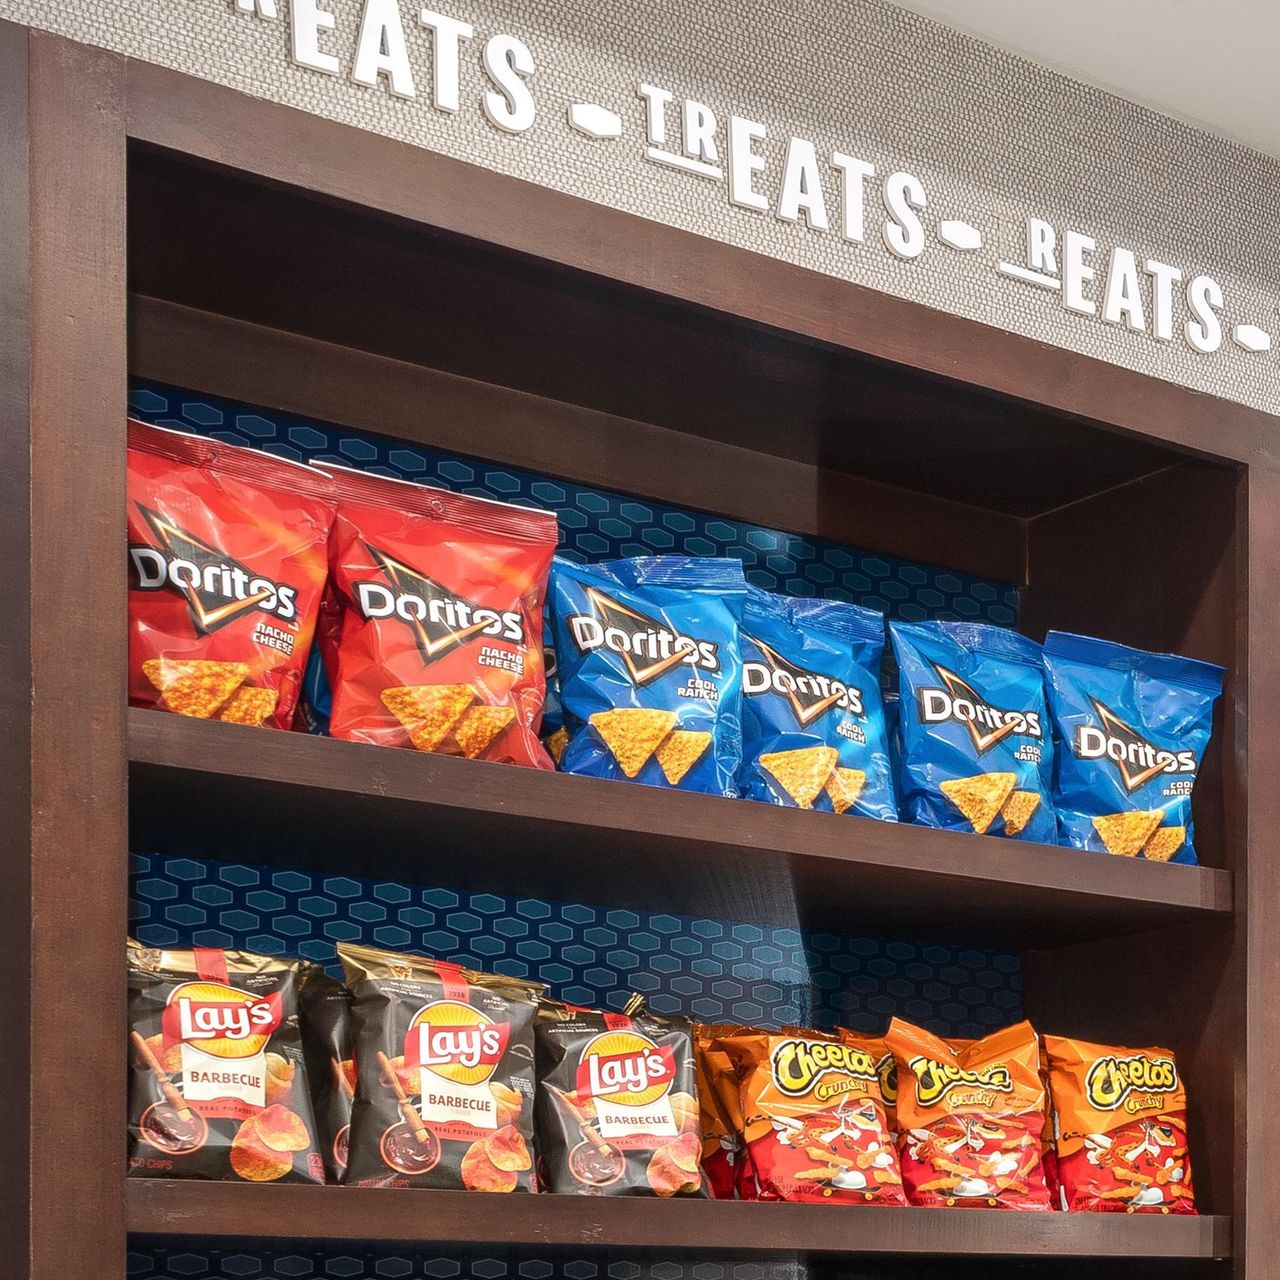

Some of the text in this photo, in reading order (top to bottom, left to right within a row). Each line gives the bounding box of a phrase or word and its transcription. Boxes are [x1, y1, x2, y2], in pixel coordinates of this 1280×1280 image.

[235, 0, 535, 133] EATS
[639, 82, 927, 259] TREATS
[134, 547, 296, 618] Doritos
[257, 623, 293, 640] NACHO
[359, 583, 523, 640] Doritos
[253, 635, 293, 655] CHEESE
[478, 656, 524, 674] CHEESE
[481, 647, 523, 663] NACHO
[573, 615, 717, 670] Doritos
[742, 663, 861, 715] Doritos
[924, 690, 1041, 736] Doritos
[1080, 726, 1195, 772] Doritos
[179, 997, 272, 1039] Lay's
[420, 1022, 499, 1067] Lay's
[191, 1071, 261, 1088] BARBECUE
[590, 1048, 667, 1096] Lay's
[775, 1042, 876, 1094] Cheetos
[1090, 1058, 1175, 1108] Cheetos
[429, 1094, 491, 1112] BARBECUE
[606, 1115, 668, 1125] BARBECUE
